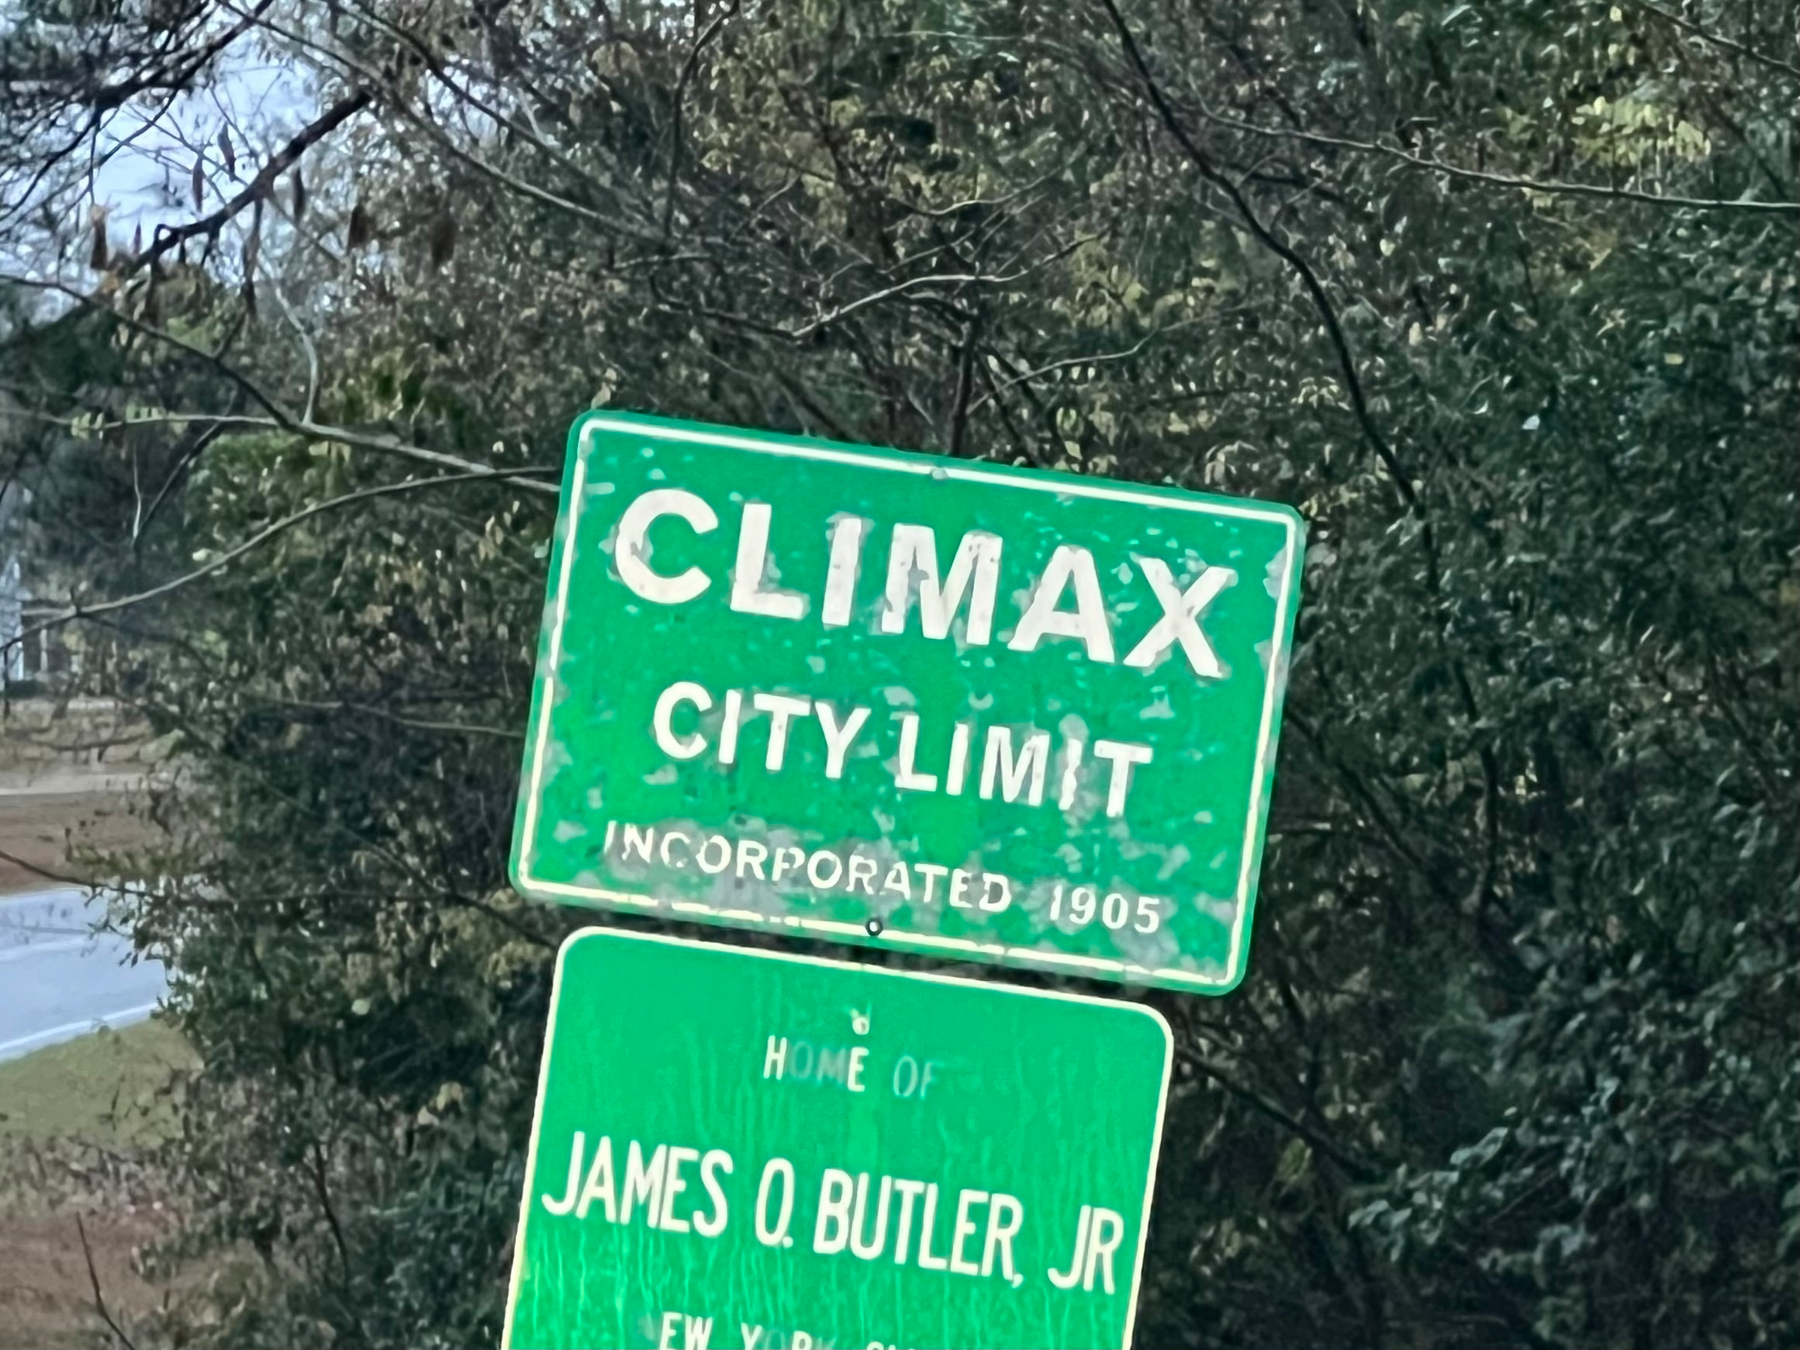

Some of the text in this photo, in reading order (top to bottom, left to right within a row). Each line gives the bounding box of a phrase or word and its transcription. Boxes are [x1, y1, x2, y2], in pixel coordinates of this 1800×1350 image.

[615, 488, 1237, 679] CLIMAX
[653, 681, 1154, 818] CITY LIMIT
[603, 820, 1161, 934] INCORPORATED 1905
[763, 1034, 945, 1099] HOME OF
[541, 1130, 734, 1238] JAMES
[812, 1167, 1025, 1289] BUTLER,
[1047, 1204, 1125, 1295] JR
